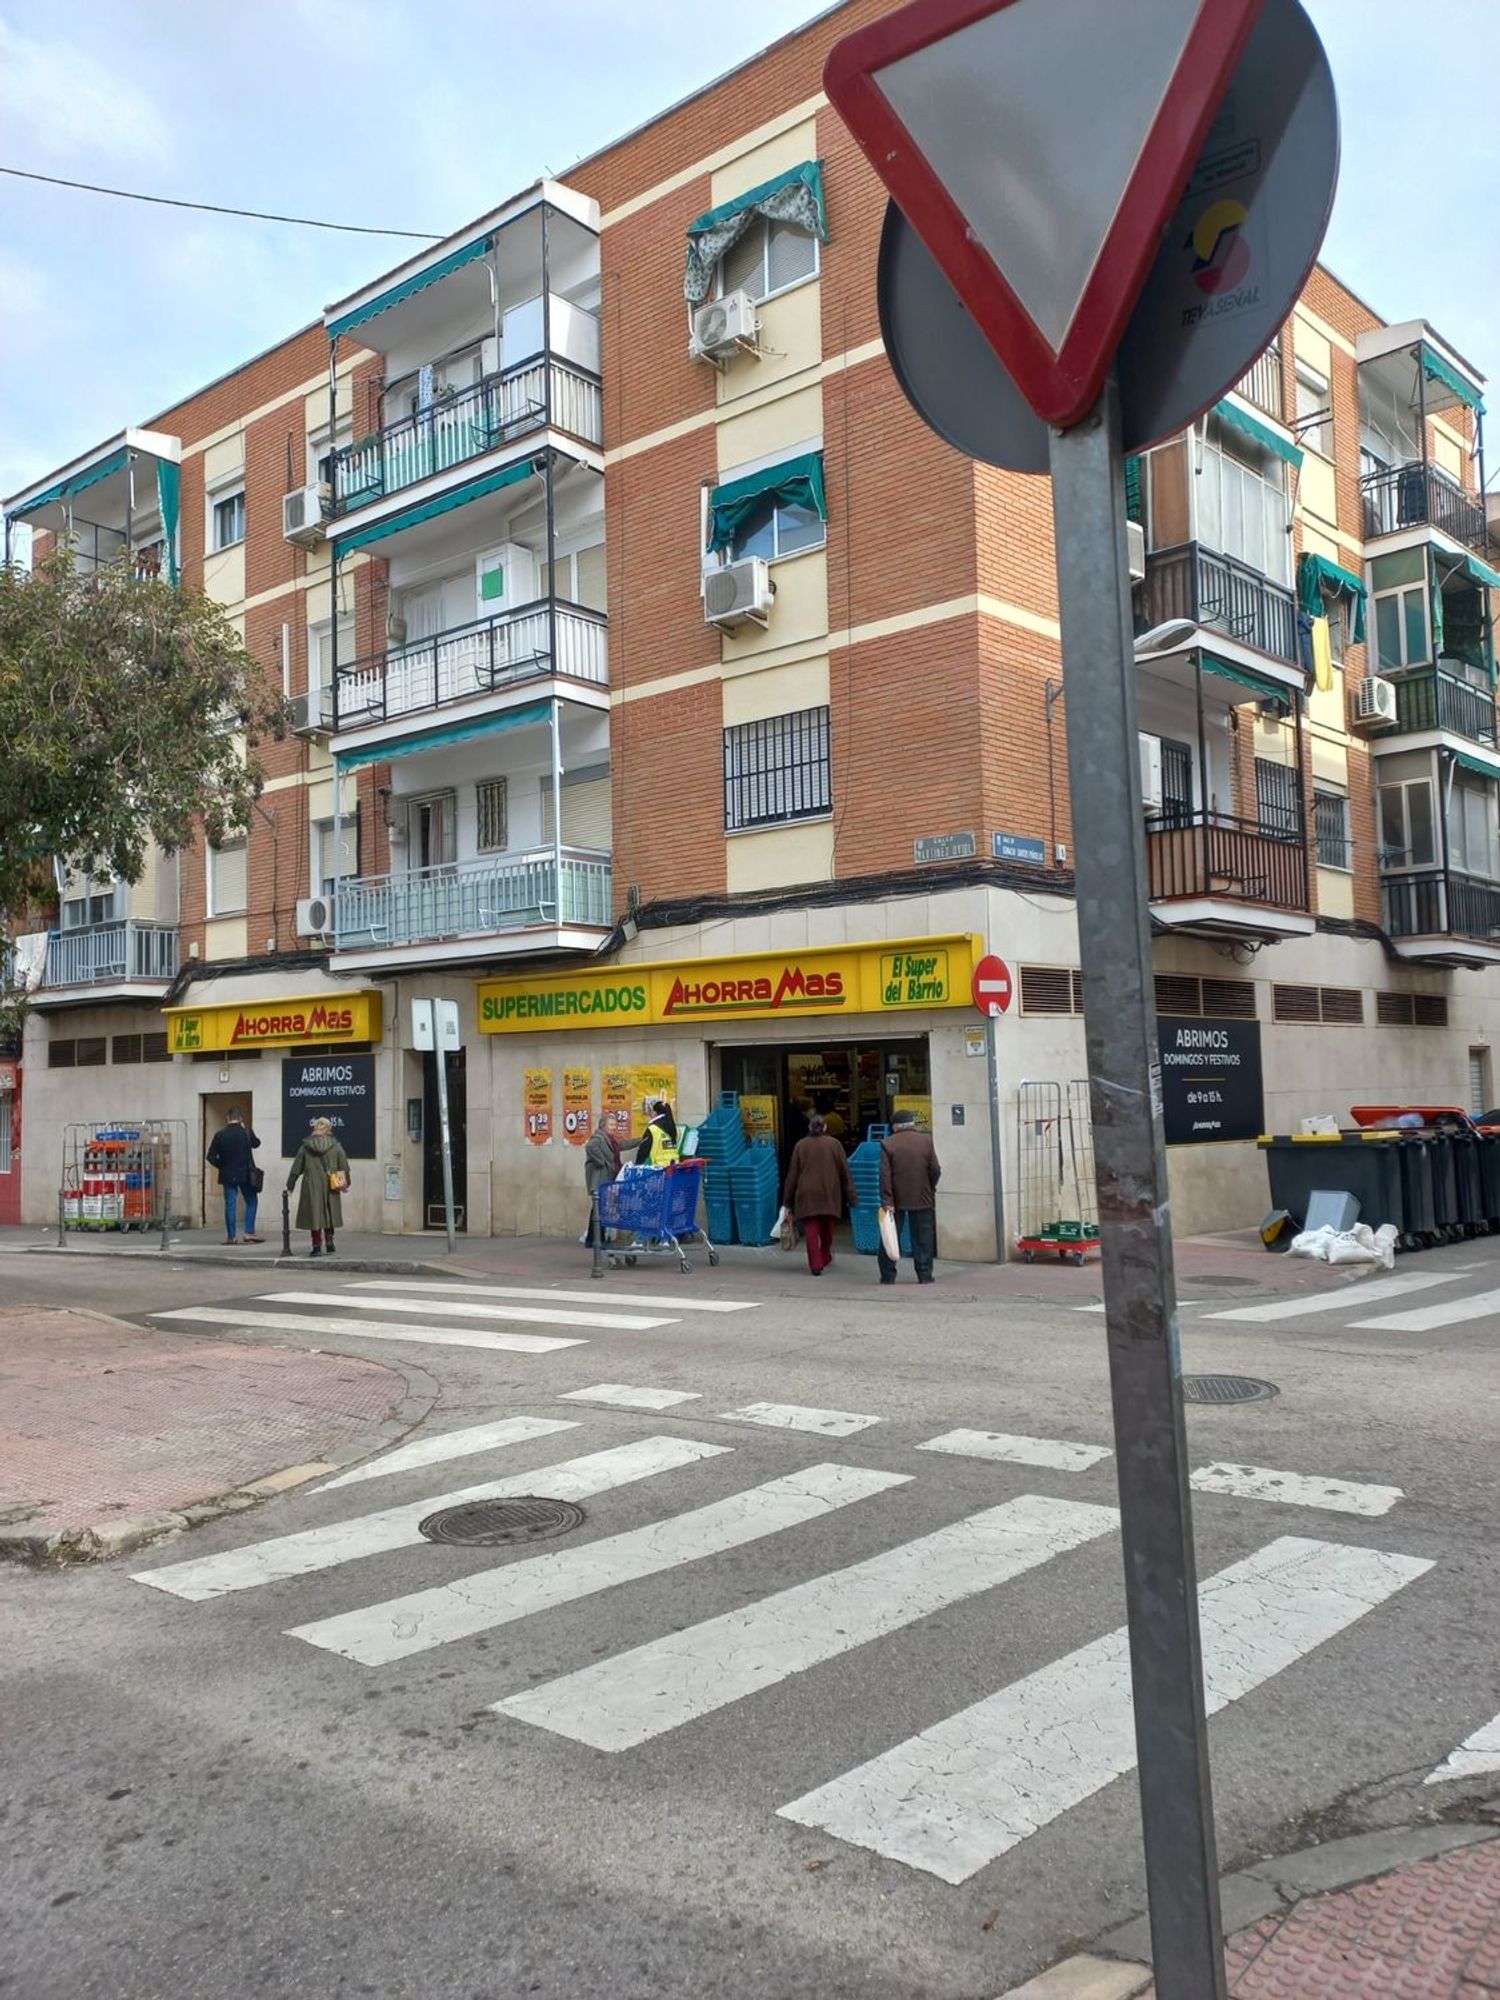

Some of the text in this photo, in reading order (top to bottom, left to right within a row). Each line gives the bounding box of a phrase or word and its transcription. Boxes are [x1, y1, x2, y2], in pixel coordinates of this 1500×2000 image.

[892, 954, 937, 981] El Super
[885, 978, 943, 1002] del Barrio
[482, 985, 646, 1021] SUPERMERCADOS
[1176, 1028, 1229, 1048] ABRIMOS
[1163, 1053, 1241, 1066] DOMINGOS Y FESTIVOS
[301, 1065, 353, 1082] ABRIMOS
[289, 1085, 366, 1097] DOMINGOS Y FESTIVOS
[650, 1078, 671, 1088] VIDA
[1186, 1091, 1197, 1103] de
[1208, 1090, 1216, 1103] 15
